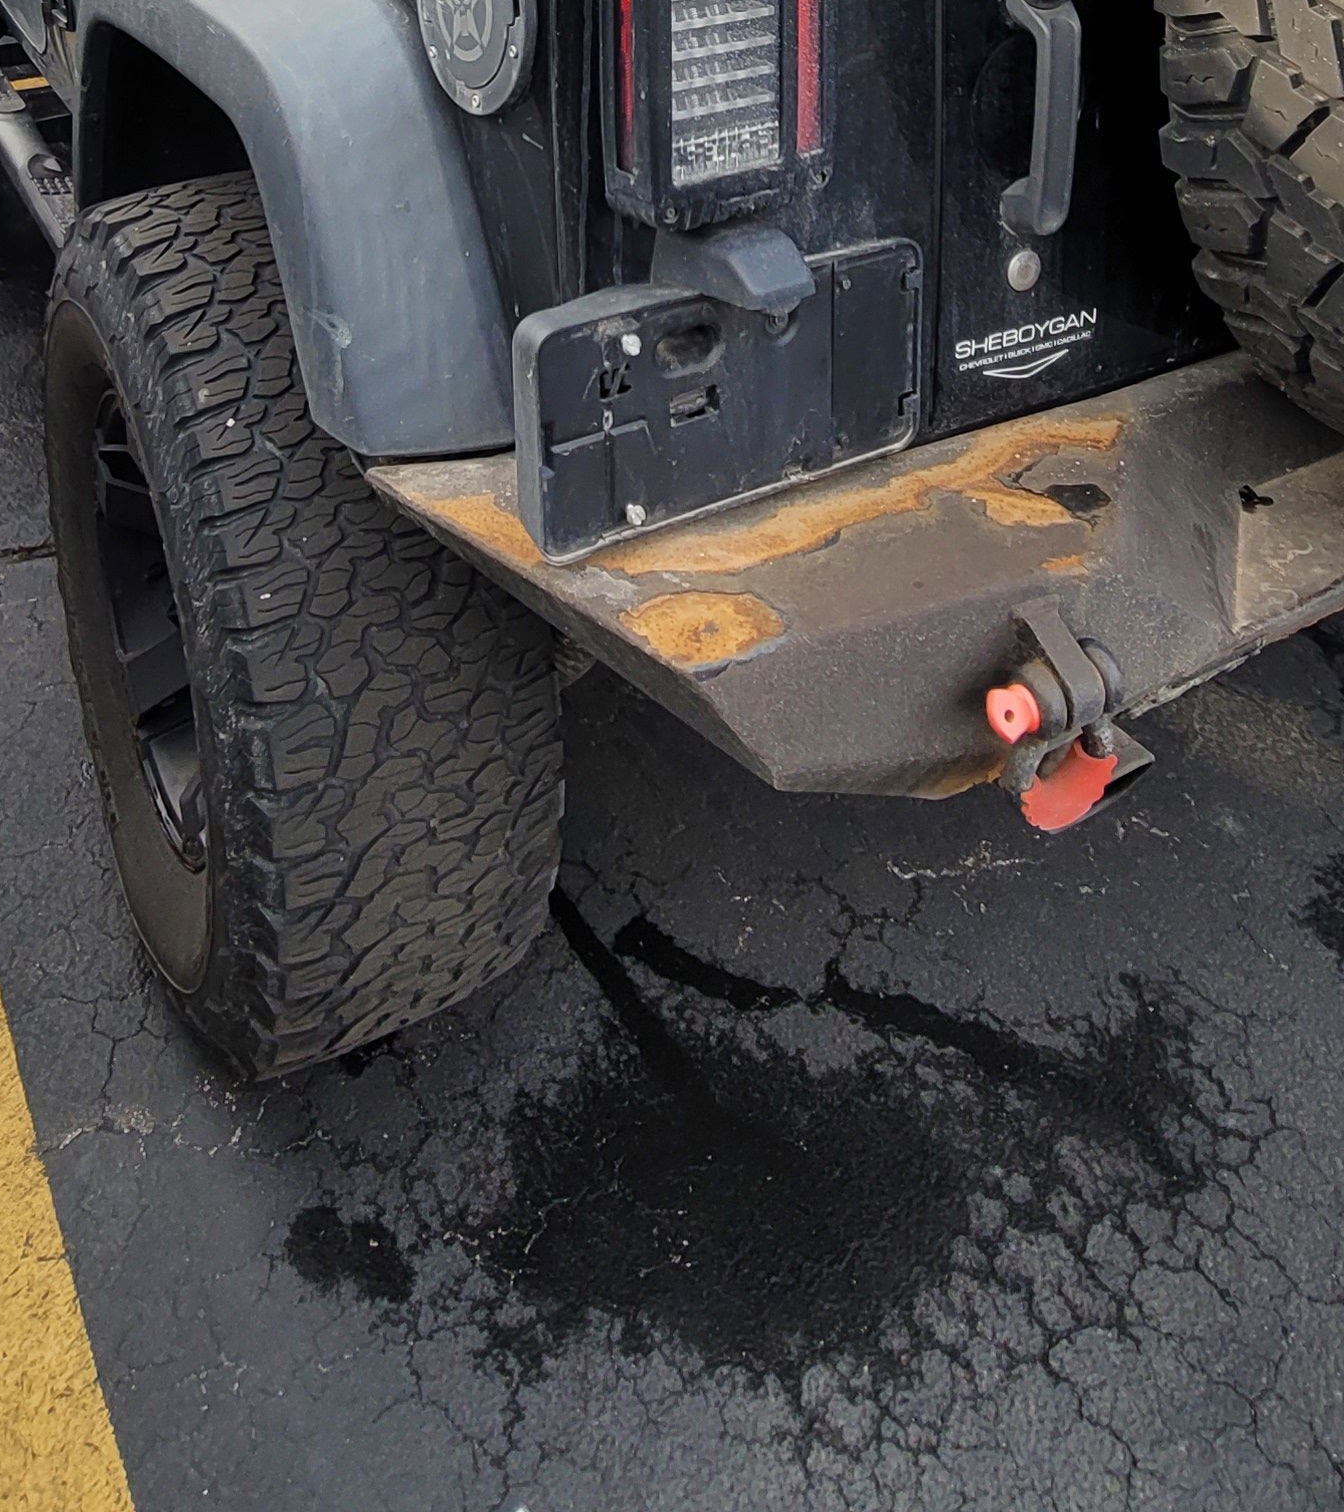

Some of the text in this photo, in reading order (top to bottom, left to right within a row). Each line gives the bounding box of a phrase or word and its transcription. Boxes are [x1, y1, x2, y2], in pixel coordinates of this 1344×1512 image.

[954, 306, 1098, 360] SHEBOYGAN
[958, 330, 1092, 372] CHEVROLET BUICK GMC CADILLAC
